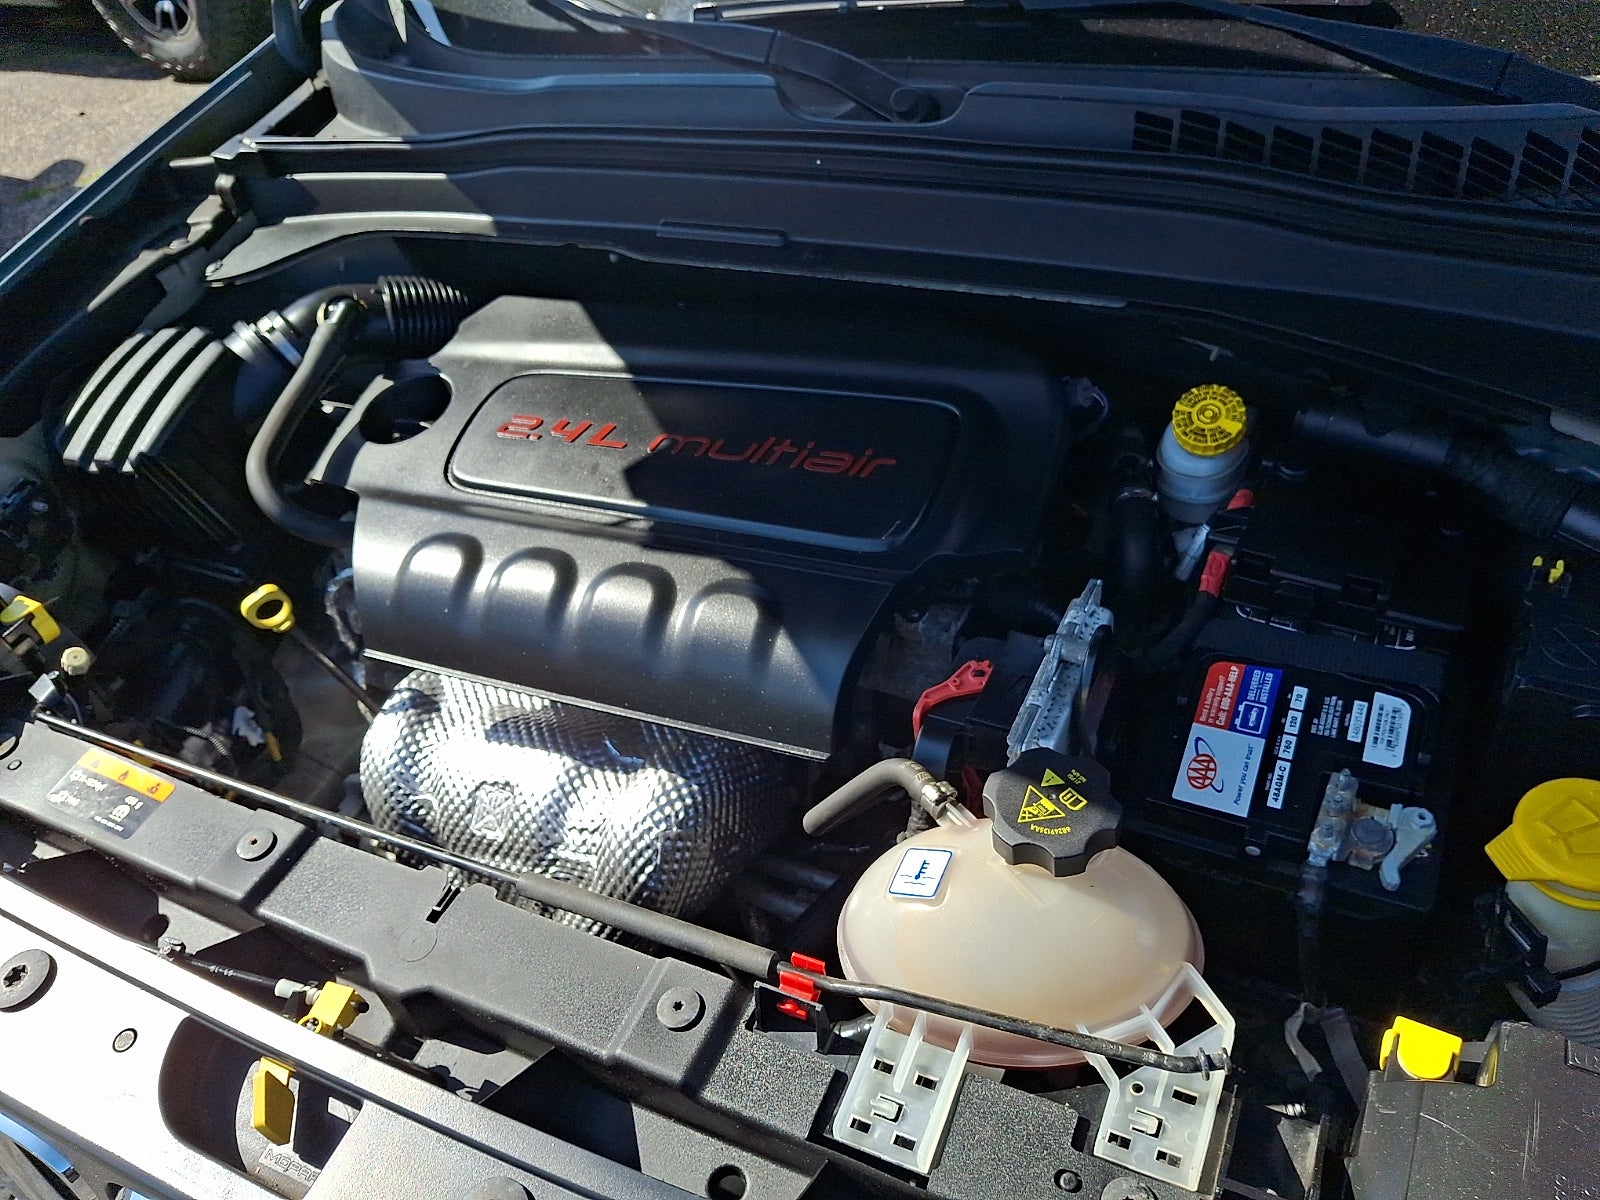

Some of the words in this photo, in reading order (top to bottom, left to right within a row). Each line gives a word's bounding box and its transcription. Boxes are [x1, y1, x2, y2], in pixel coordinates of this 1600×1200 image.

[496, 414, 628, 449] 2.4L
[648, 433, 896, 478] multiair
[1247, 669, 1261, 700] DELIVERED
[1260, 672, 1273, 703] INSTALLED
[1294, 693, 1303, 703] 70
[1216, 710, 1226, 726] Call:
[1289, 715, 1297, 728] 120
[1283, 740, 1292, 754] 760
[1187, 754, 1216, 789] AAA
[1233, 784, 1243, 805] Power
[1239, 772, 1248, 785] you
